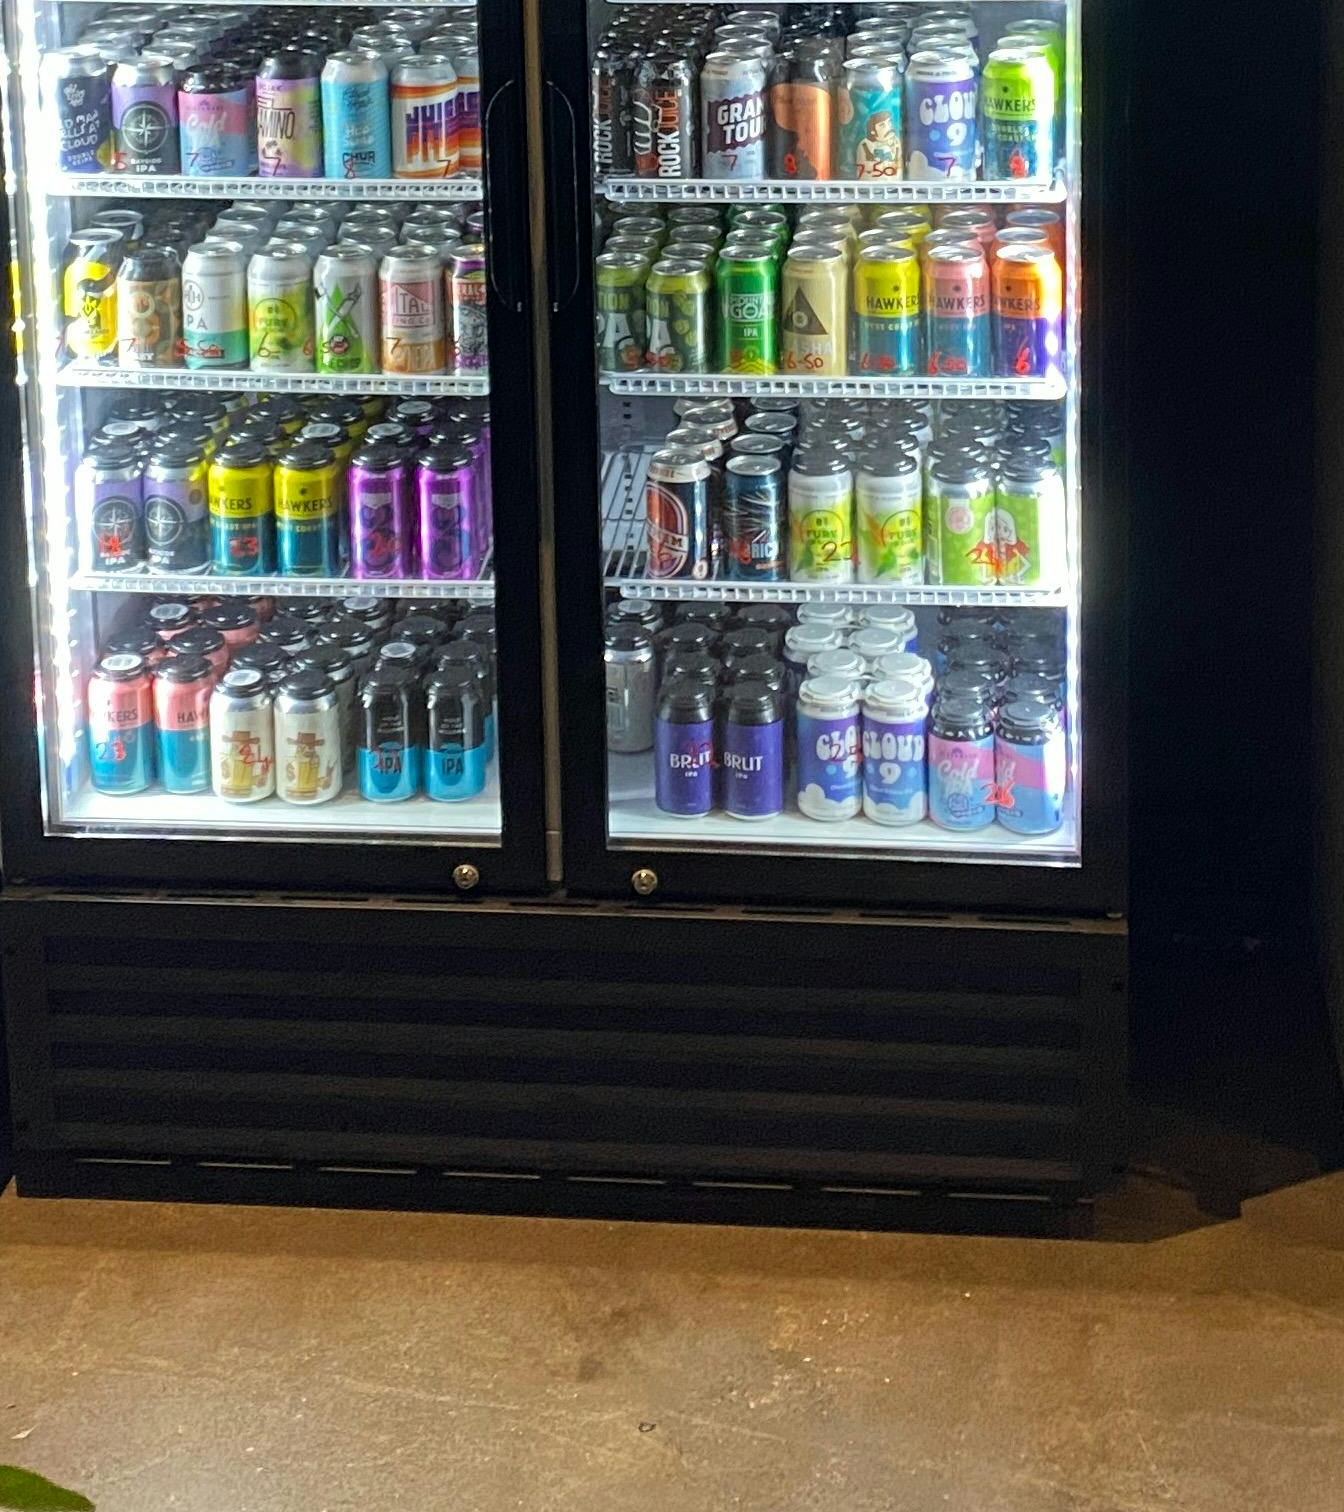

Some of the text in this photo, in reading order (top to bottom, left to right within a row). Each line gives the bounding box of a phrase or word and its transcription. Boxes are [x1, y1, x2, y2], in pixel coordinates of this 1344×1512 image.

[716, 98, 765, 123] GRAN
[919, 90, 976, 126] CLOU
[945, 122, 968, 147] 9
[657, 131, 681, 179] ROCK
[722, 153, 738, 172] 7
[932, 154, 957, 178] 7
[135, 164, 157, 173] IPA
[742, 327, 758, 339] IPA
[385, 337, 403, 355] 7
[1015, 336, 1031, 376] 6
[785, 350, 824, 370] 6-50
[105, 555, 126, 566] IPA
[862, 733, 925, 763] CLOUD
[442, 757, 464, 776] IPA
[723, 751, 764, 772] BRUT
[878, 762, 902, 785] 9
